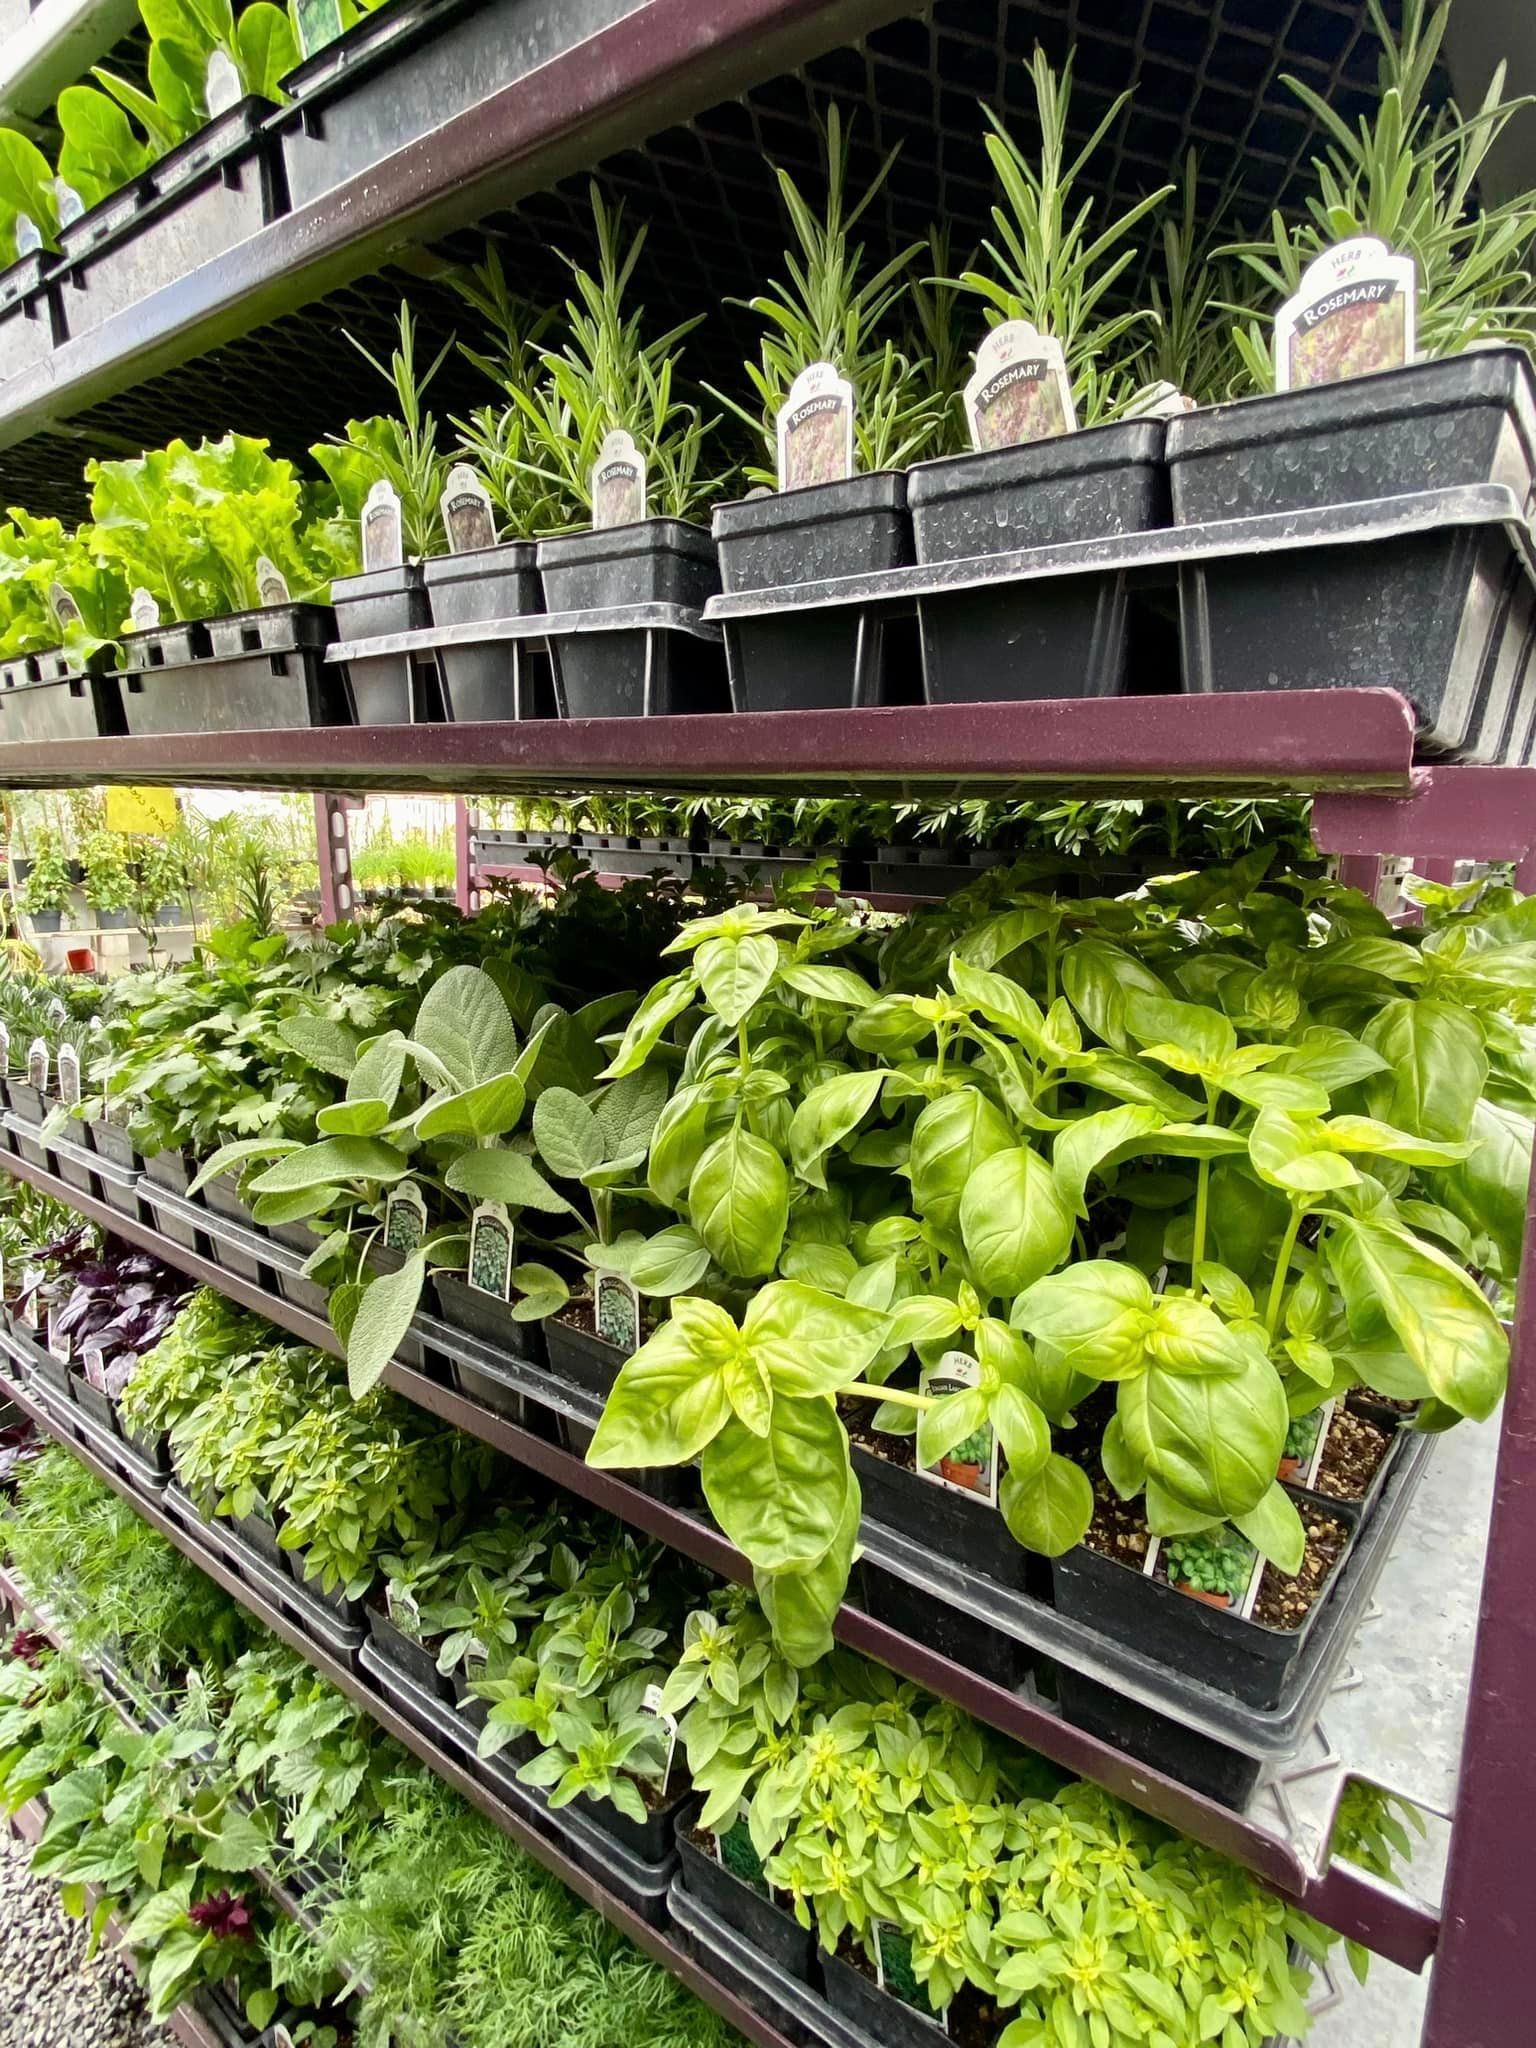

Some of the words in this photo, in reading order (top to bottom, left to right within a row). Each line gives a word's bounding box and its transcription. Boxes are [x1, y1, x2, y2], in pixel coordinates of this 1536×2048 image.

[1331, 249, 1362, 268] HERB
[1303, 285, 1386, 325] ROSEMARY
[981, 364, 1040, 402] ROSEMARY
[792, 400, 836, 425] ROSEMARY
